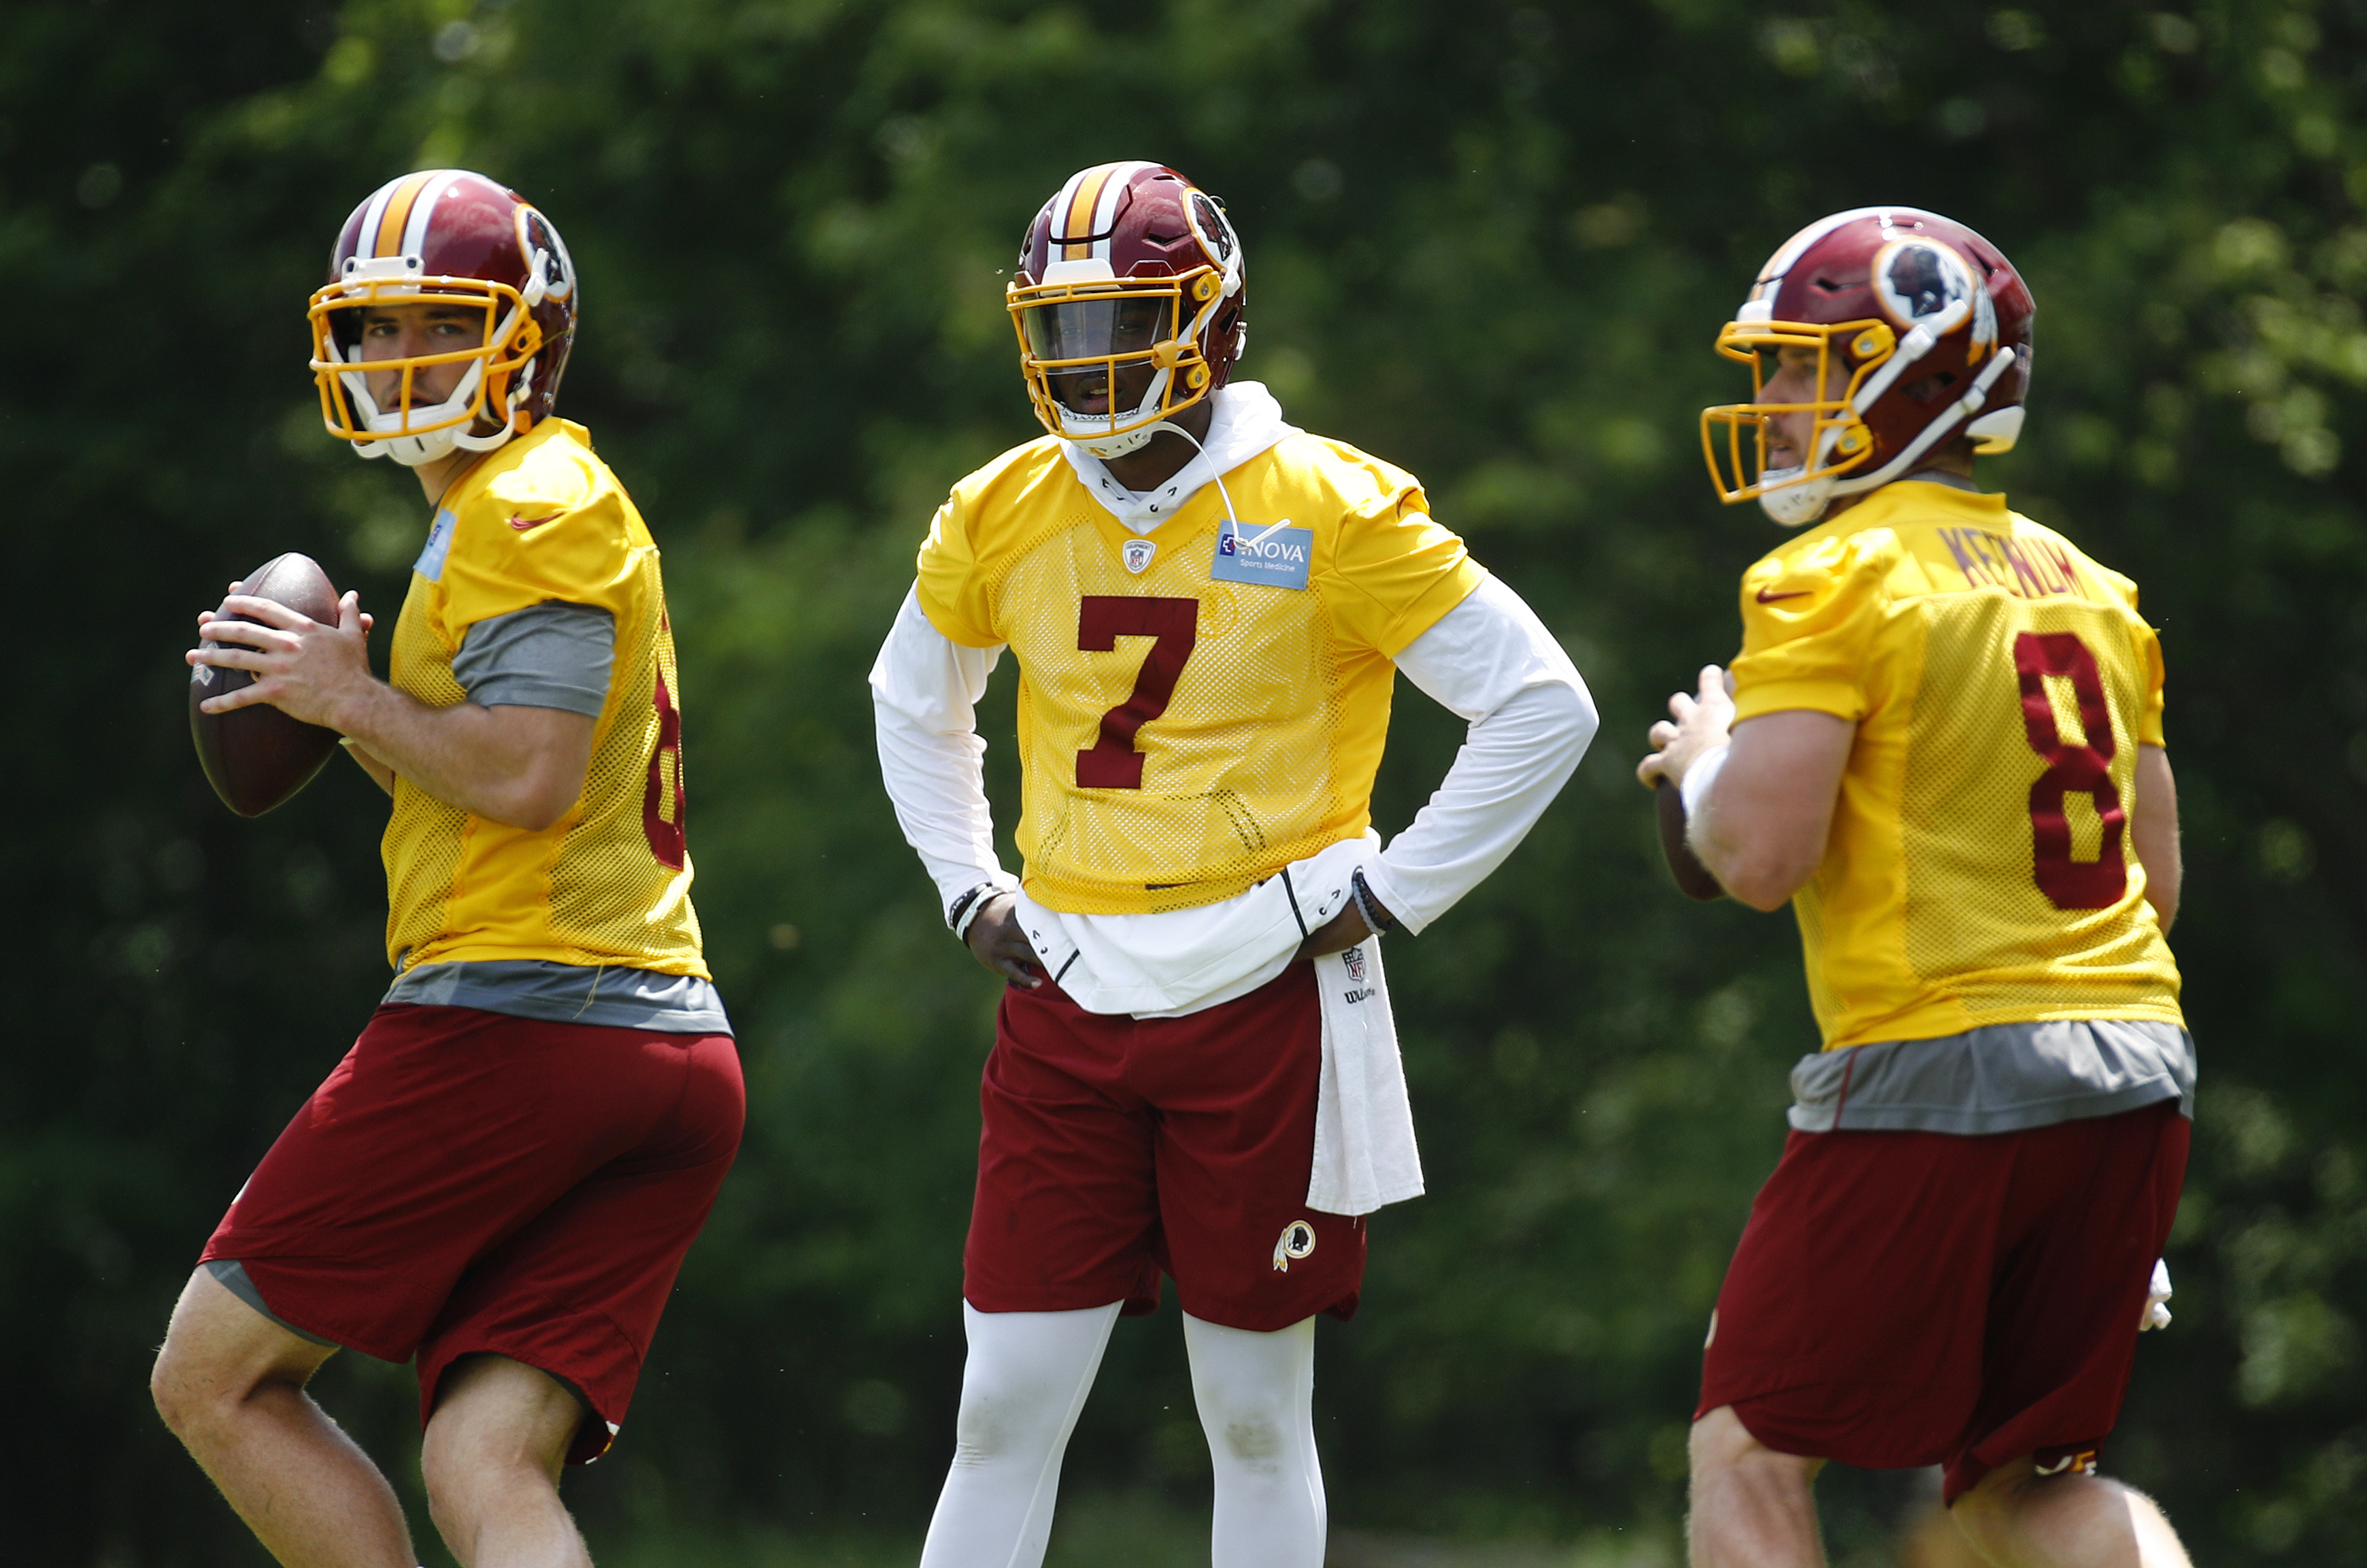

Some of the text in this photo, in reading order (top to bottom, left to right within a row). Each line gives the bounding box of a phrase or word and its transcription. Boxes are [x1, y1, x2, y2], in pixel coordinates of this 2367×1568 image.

[1240, 558, 1296, 573] Sports Medicine
[1075, 595, 1199, 789] 7
[2013, 632, 2126, 910] 8
